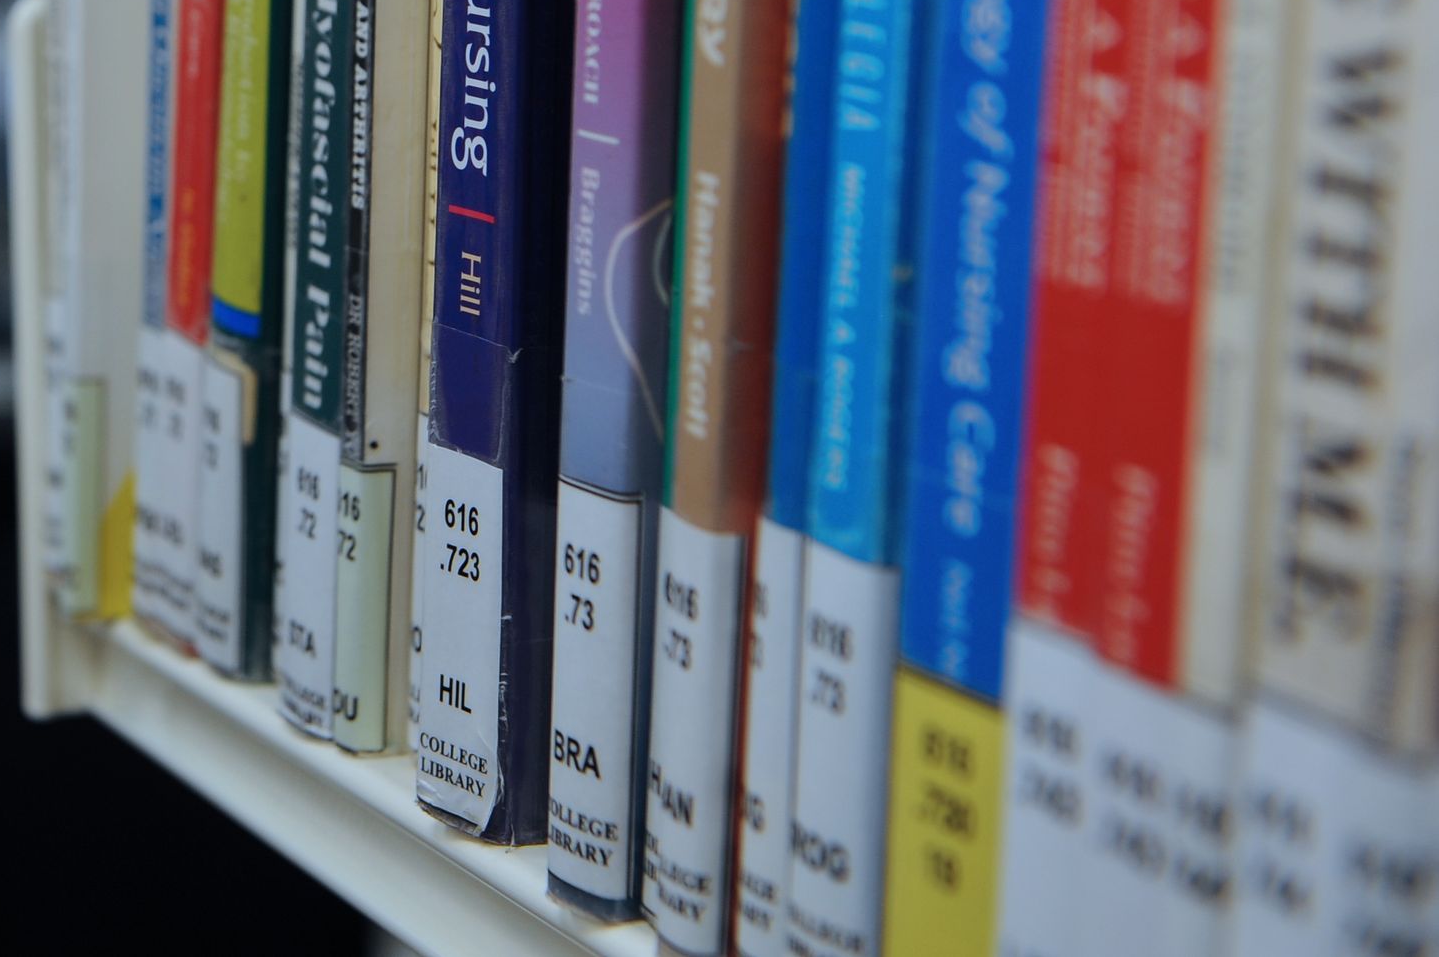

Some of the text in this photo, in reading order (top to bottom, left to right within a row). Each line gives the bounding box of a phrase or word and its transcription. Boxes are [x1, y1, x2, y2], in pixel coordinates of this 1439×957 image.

[354, 0, 370, 59] AND
[351, 62, 368, 211] ARTHRITIS
[958, 78, 1015, 161] of
[1291, 47, 1407, 398] WITH
[460, 250, 482, 317] Hill
[941, 158, 1011, 391] Nursing
[301, 285, 331, 412] Pain
[941, 398, 996, 537] Care
[444, 498, 479, 536] 616
[440, 543, 480, 582] .723
[564, 542, 600, 585] 616
[564, 593, 595, 632] .73
[664, 571, 699, 622] 616
[439, 673, 472, 714] HIL
[419, 731, 488, 775] COLLEGE
[420, 755, 486, 798] LIBRARY
[554, 728, 602, 780] BRA
[649, 755, 694, 830] HAN
